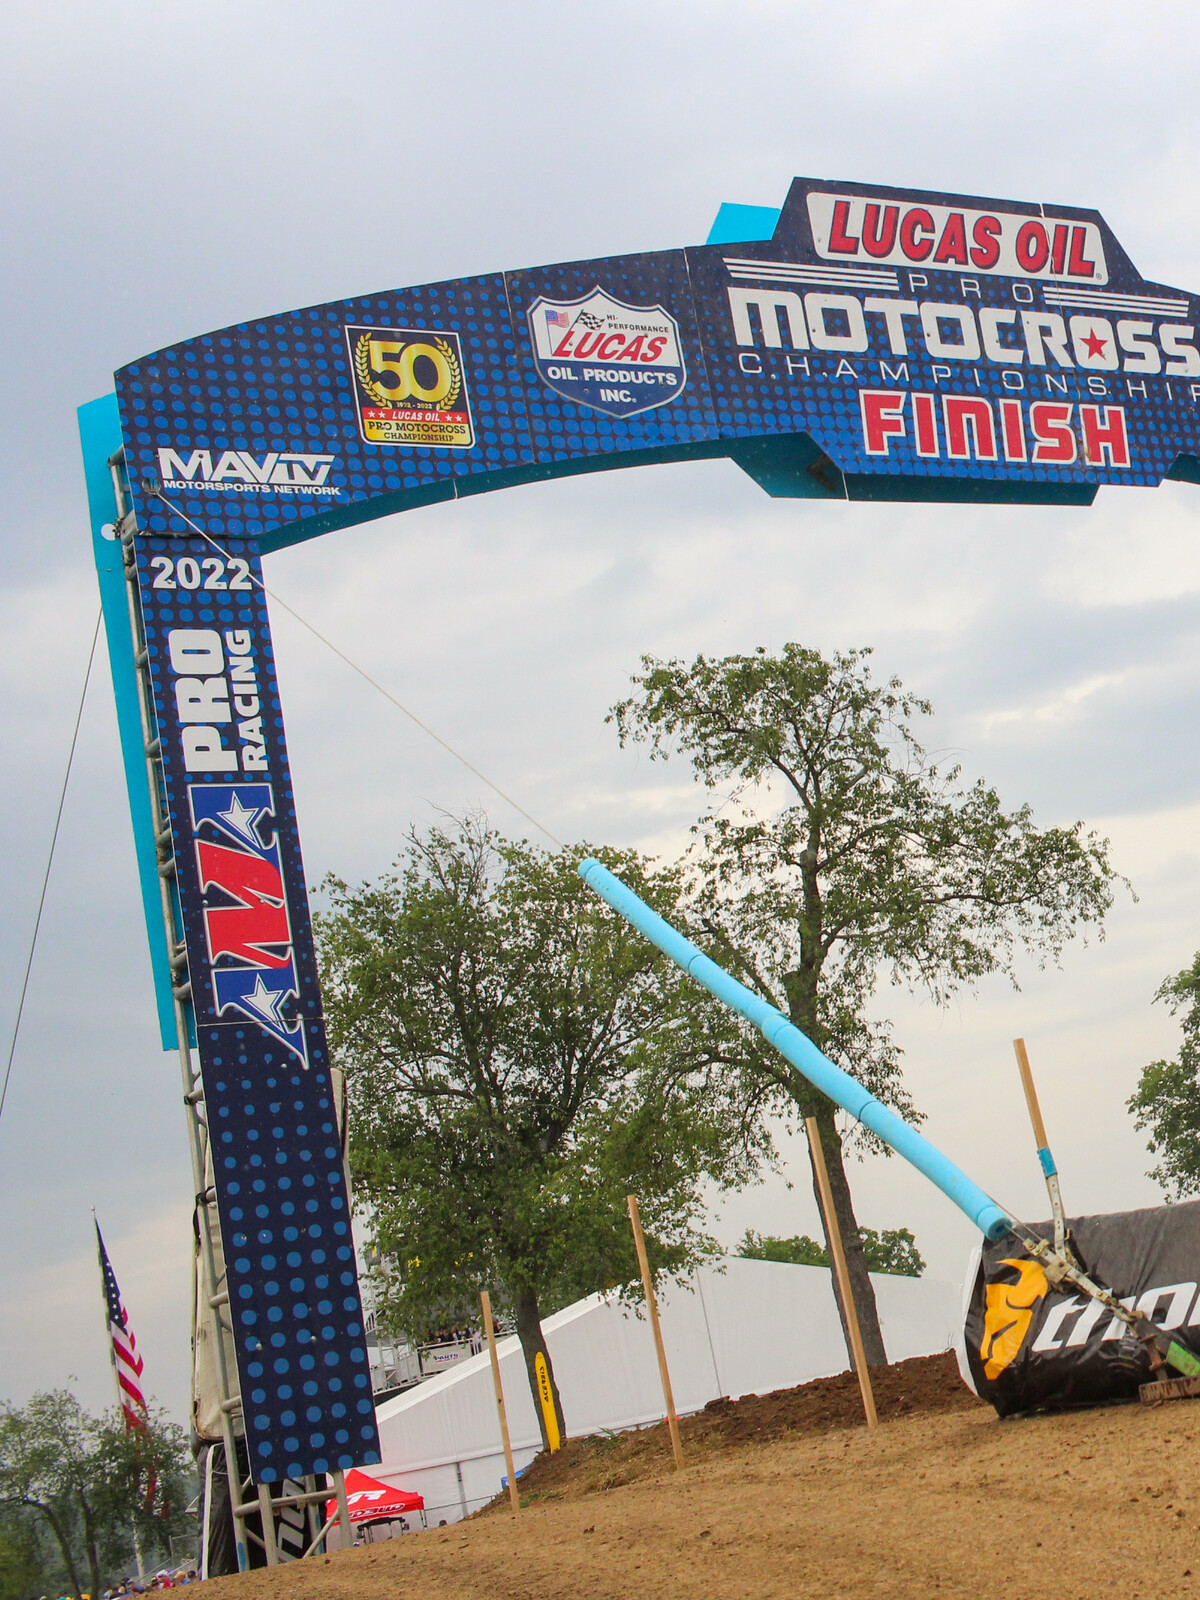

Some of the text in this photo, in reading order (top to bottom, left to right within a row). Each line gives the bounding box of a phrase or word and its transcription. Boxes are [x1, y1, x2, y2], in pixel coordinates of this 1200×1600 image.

[826, 199, 1097, 278] LUCAS OIL
[909, 273, 1034, 304] PRO
[608, 322, 670, 334] PERFORMANCE
[551, 330, 669, 363] LUCAS
[368, 339, 452, 403] 50
[547, 366, 678, 386] OIL PRODUCTS
[367, 420, 466, 434] PRO MOTOCROSS
[391, 410, 440, 422] LUCAS OIL
[858, 388, 1132, 470] FINISH
[383, 431, 455, 442] CHAMPIONSHIP
[162, 479, 342, 496] MOTORSPORTS NETWORK
[150, 556, 253, 590] 2022
[168, 628, 239, 771] PRO
[225, 629, 269, 771] RACING
[187, 782, 310, 1070] AMA
